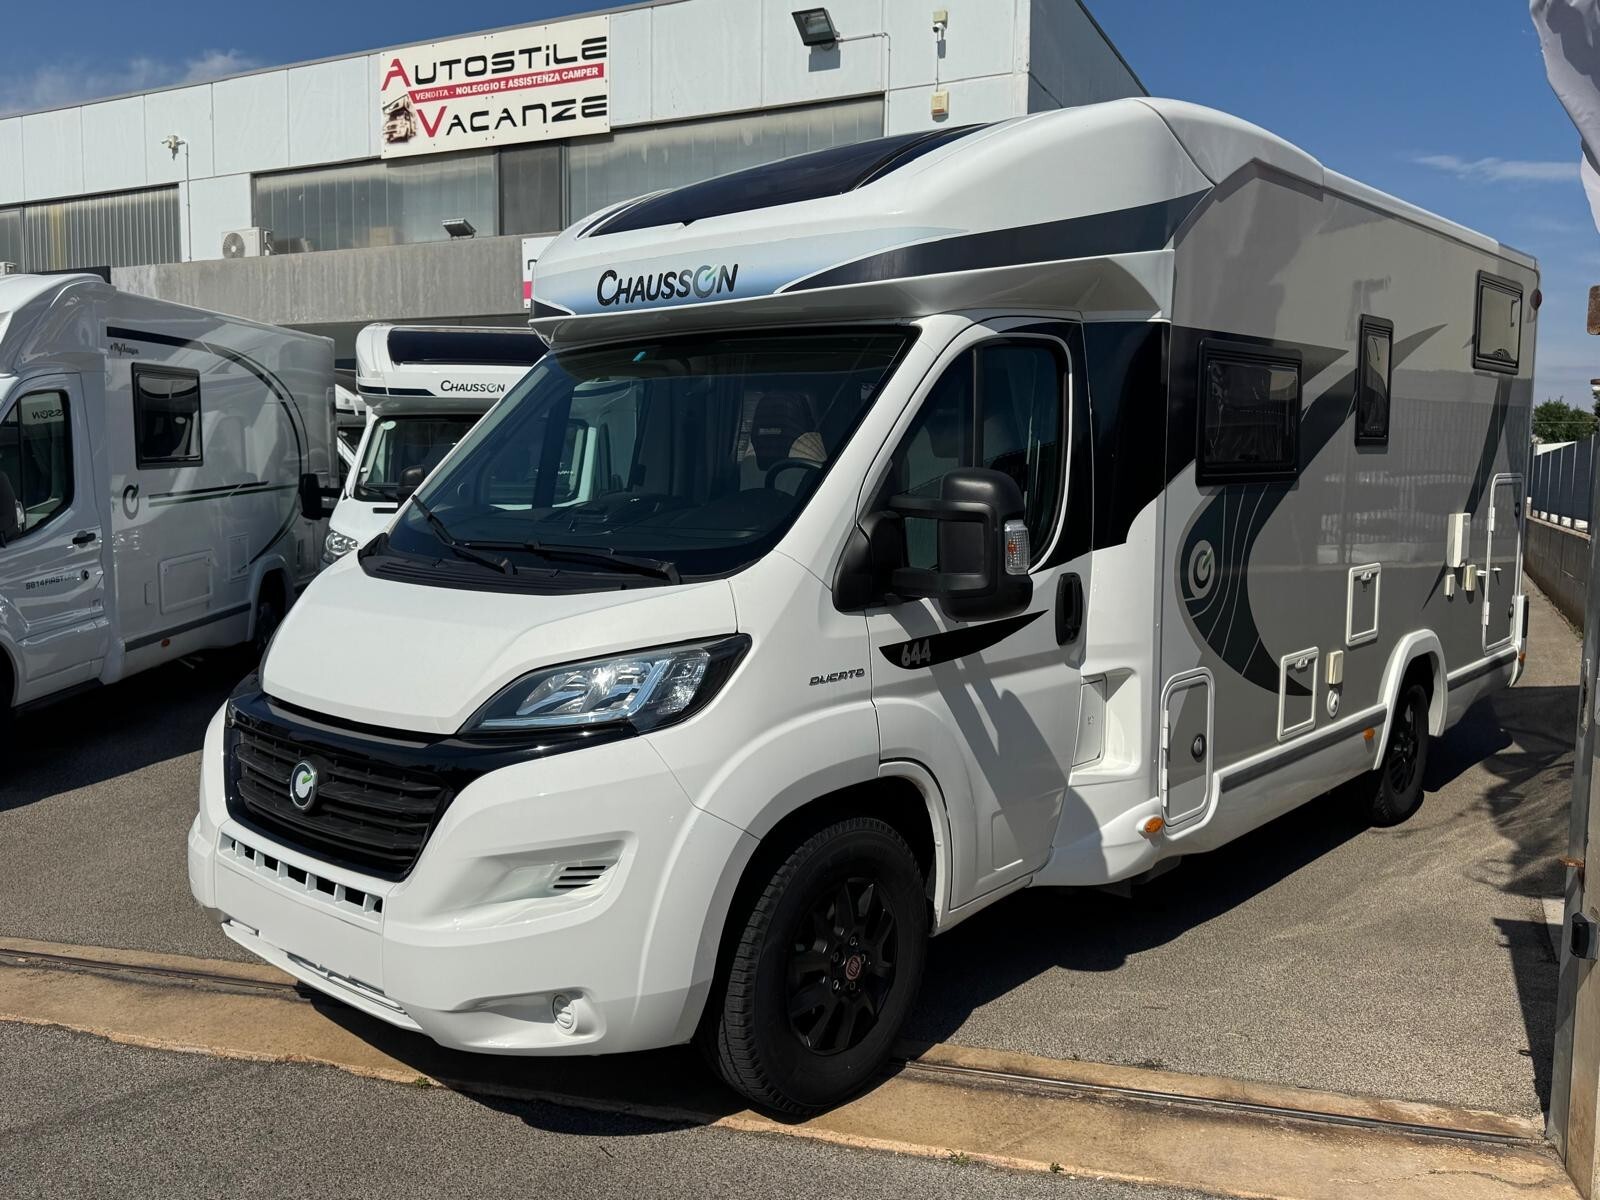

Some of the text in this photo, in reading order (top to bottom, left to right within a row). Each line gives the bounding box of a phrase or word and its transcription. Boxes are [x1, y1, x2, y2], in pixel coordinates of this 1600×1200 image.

[415, 89, 449, 101] VENDITA
[455, 82, 500, 96] NOLEGGIO
[500, 80, 506, 90] E
[507, 73, 561, 89] ASSISTENZA
[562, 67, 599, 81] CAMPER
[416, 94, 607, 138] VACANZE
[597, 263, 739, 306] CHAUSSON
[440, 379, 506, 393] CHAUSSON
[901, 639, 931, 667] 644
[809, 668, 866, 686] DUCATO
